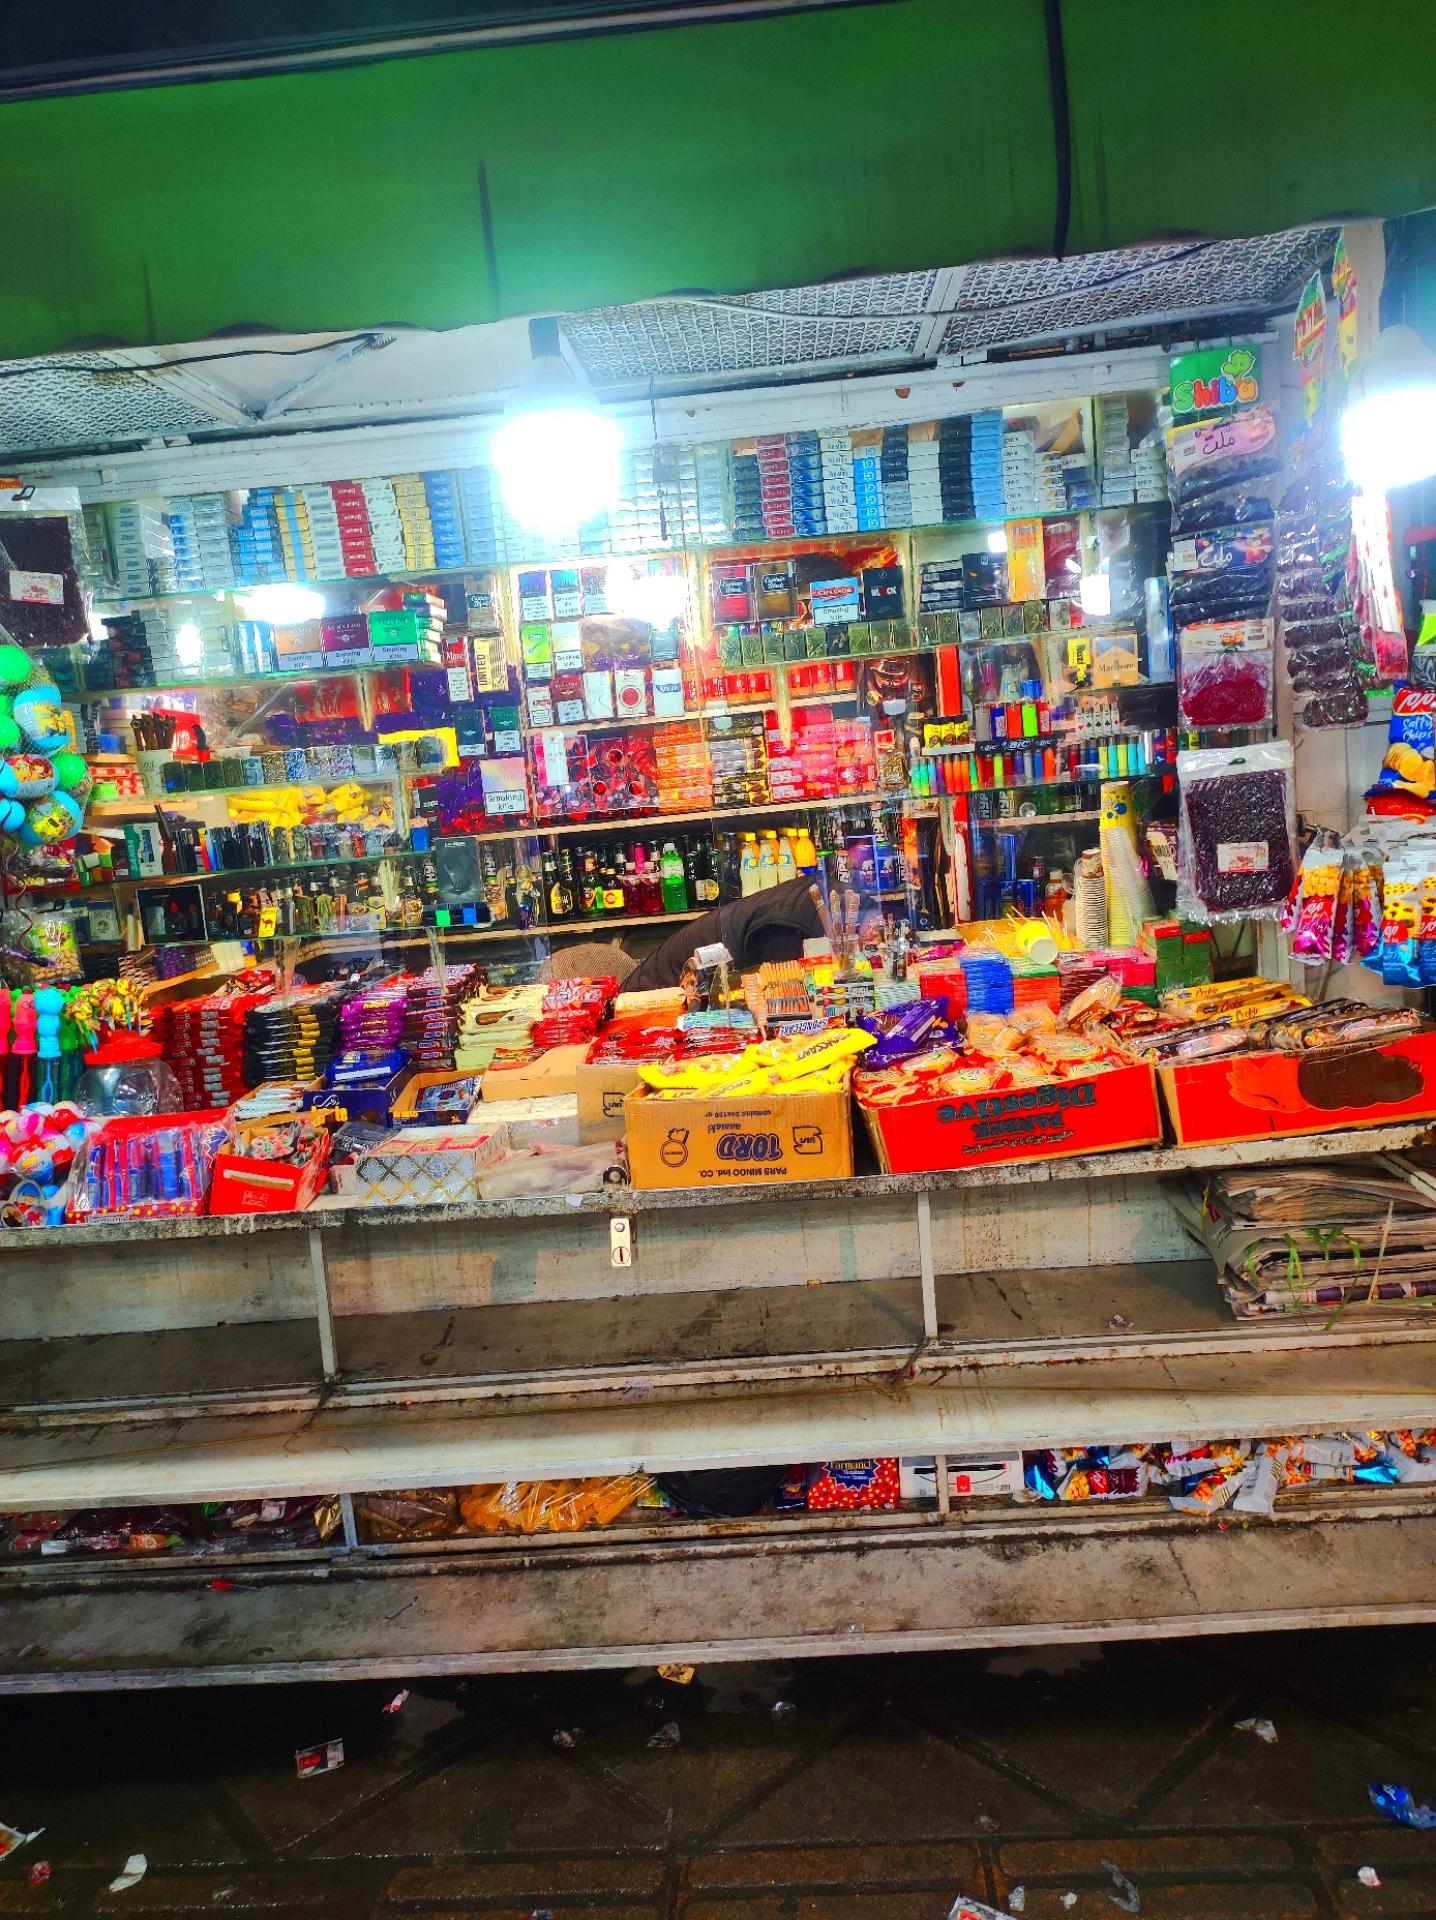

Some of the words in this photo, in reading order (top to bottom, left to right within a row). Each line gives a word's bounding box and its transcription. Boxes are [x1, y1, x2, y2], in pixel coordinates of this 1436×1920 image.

[1171, 376, 1259, 414] Shiba
[476, 654, 488, 686] UNITED
[1008, 739, 1031, 750] BIC
[487, 793, 523, 803] Smoking
[937, 1083, 1096, 1123] Digestive
[698, 1169, 714, 1178] CO.
[716, 1168, 731, 1177] ind.
[733, 1167, 763, 1177] MINOO
[765, 1166, 787, 1176] PARS
[830, 1460, 871, 1470] Farmand
